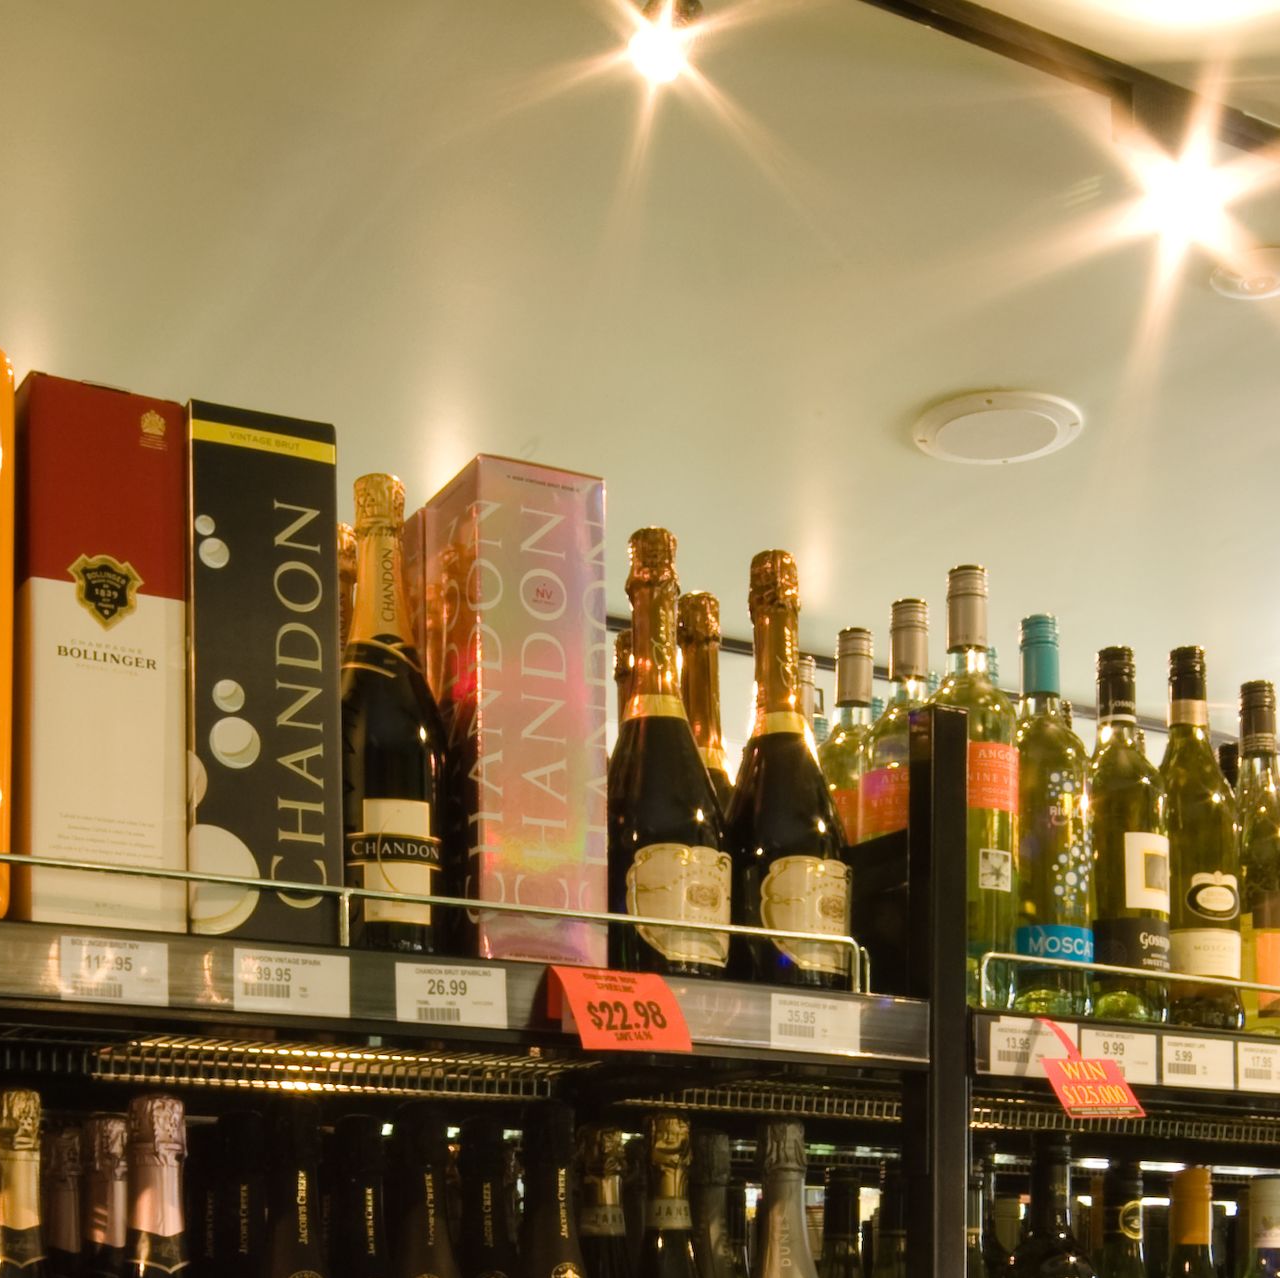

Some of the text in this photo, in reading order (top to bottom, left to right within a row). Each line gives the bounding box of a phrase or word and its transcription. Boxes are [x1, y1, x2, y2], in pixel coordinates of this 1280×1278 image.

[381, 547, 394, 622] CHANDON
[57, 645, 157, 671] BOLLINGER
[270, 498, 327, 909] CHANDON
[351, 840, 440, 859] CHANDON
[255, 967, 291, 982] 39.95
[427, 979, 467, 996] 26.99
[587, 1001, 667, 1030] $22.98
[787, 1010, 816, 1025] 35.95
[1006, 1037, 1031, 1050] 13.95
[1103, 1042, 1125, 1056] 9.99
[1175, 1050, 1192, 1062] 5.99
[1058, 1061, 1107, 1080] WIN
